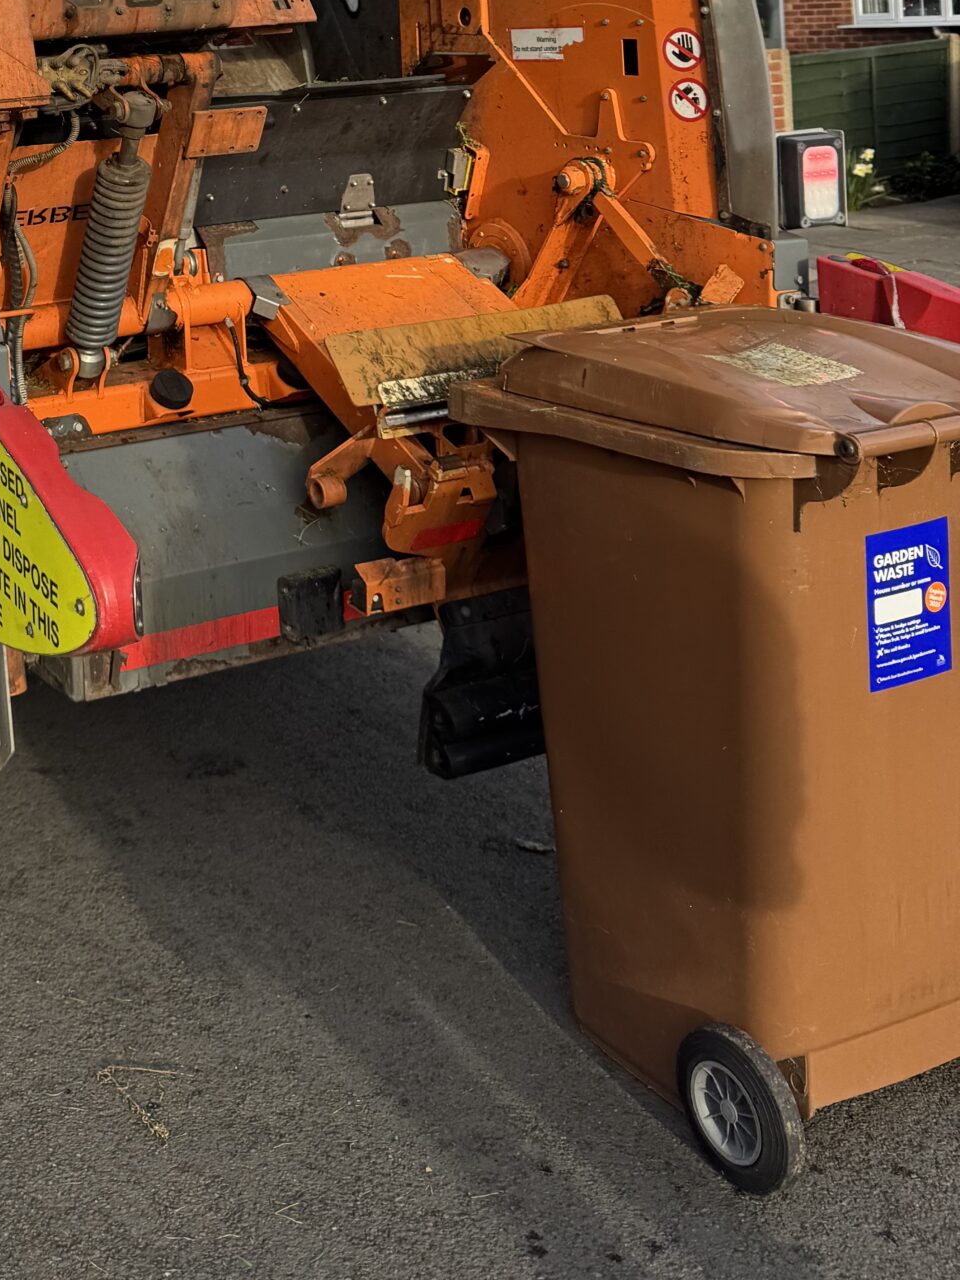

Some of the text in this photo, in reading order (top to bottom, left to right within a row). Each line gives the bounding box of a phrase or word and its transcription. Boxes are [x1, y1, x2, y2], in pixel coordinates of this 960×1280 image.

[536, 36, 557, 44] Warning
[16, 203, 92, 227] ERBE
[873, 545, 923, 568] GARDEN
[2, 535, 59, 610] DISPOSE
[873, 561, 915, 583] WASTE
[14, 582, 27, 616] IN
[29, 598, 60, 648] THIS
